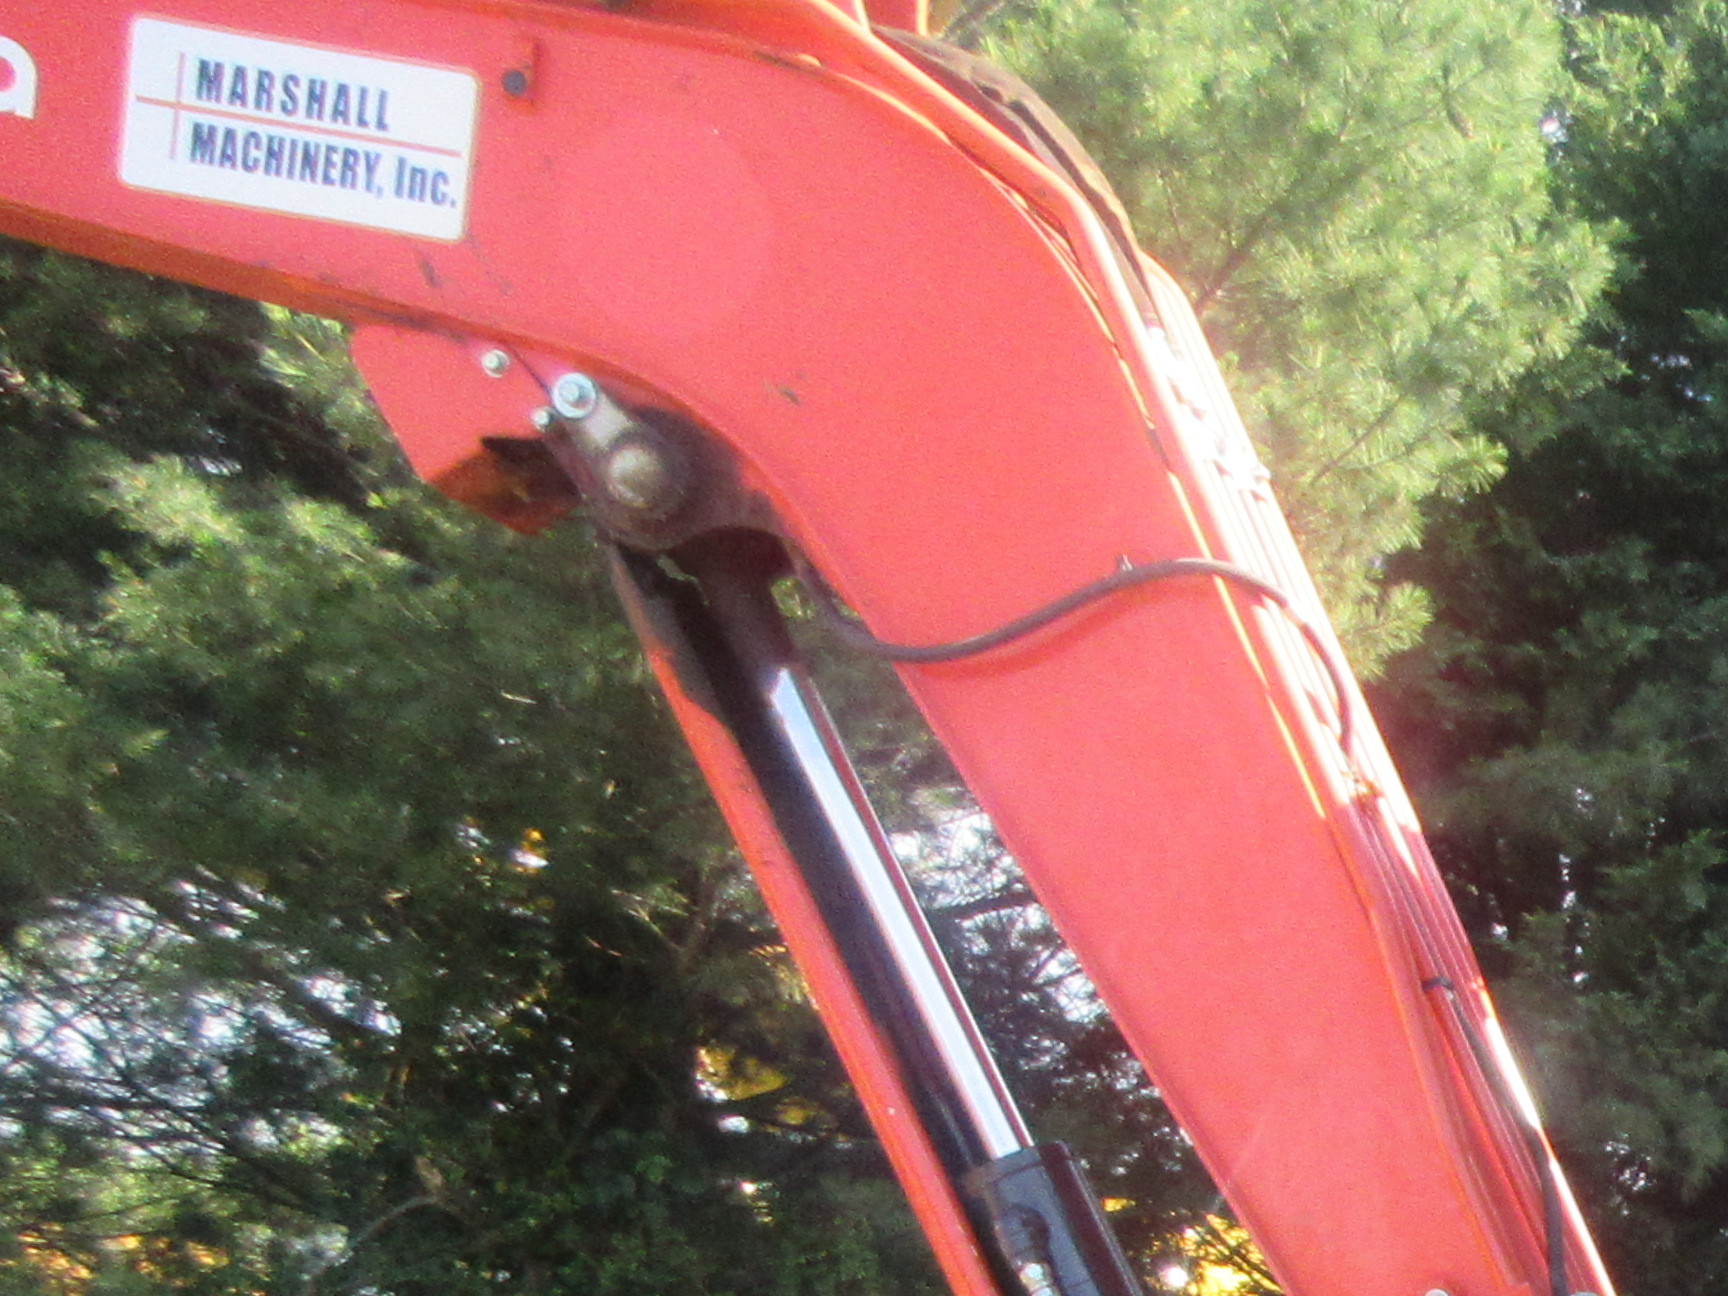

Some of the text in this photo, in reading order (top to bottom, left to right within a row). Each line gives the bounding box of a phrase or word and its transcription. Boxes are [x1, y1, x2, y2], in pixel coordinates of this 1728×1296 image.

[194, 58, 391, 132] MARSHALL
[189, 121, 458, 208] MACHINERY, Inc.
